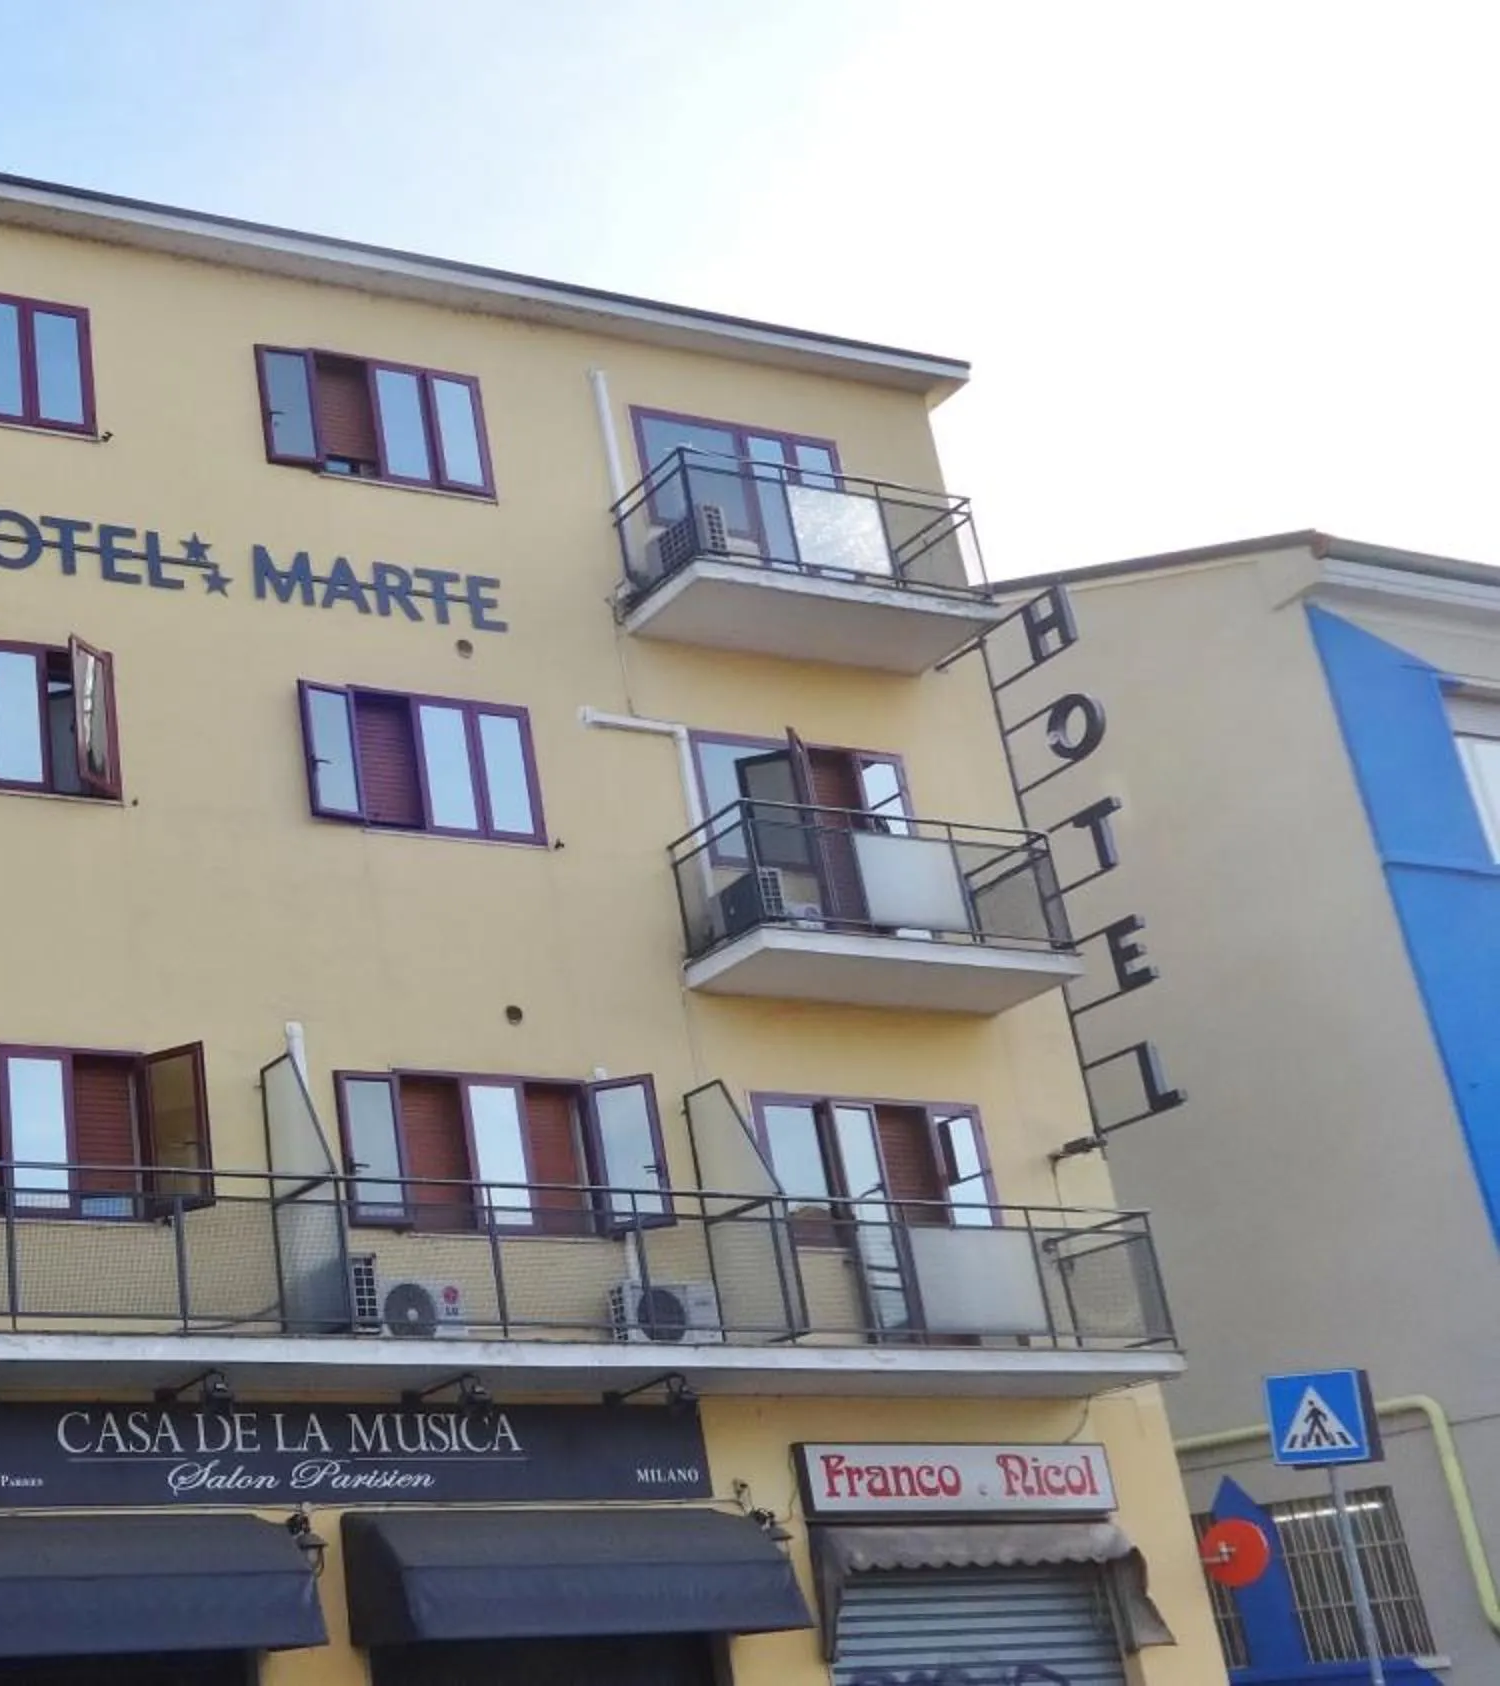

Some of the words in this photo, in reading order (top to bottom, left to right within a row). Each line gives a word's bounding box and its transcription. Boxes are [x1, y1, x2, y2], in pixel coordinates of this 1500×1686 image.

[252, 544, 508, 632] MARTE
[1020, 584, 1188, 1115] HOTEL
[57, 1411, 185, 1453] CASA
[194, 1412, 261, 1452] DE
[270, 1412, 334, 1453] LA
[347, 1412, 523, 1453] MUSICA
[167, 1458, 281, 1498] Salon
[289, 1457, 436, 1490] Parisien
[636, 1467, 700, 1483] MILANO
[820, 1454, 963, 1498] Franco
